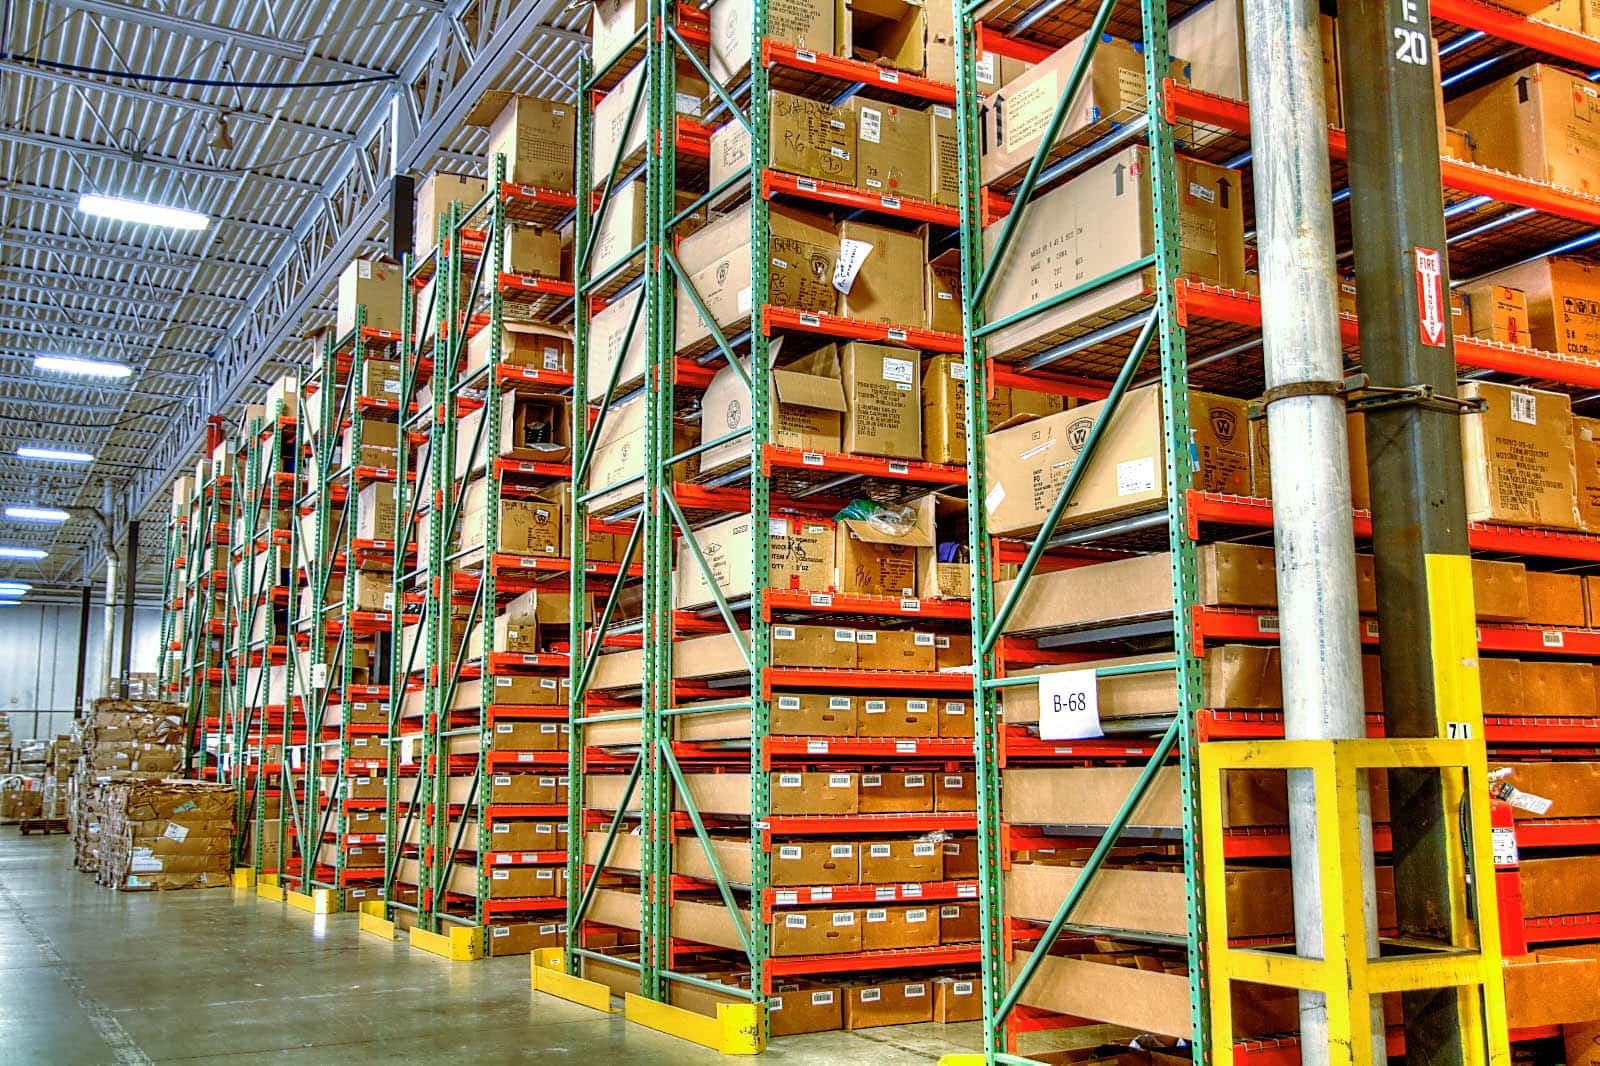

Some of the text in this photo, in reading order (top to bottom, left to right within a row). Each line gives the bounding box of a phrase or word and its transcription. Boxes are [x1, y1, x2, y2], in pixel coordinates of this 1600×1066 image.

[1393, 27, 1428, 66] 20
[1419, 257, 1437, 272] FIRE
[1053, 692, 1086, 712] B-68
[1449, 723, 1467, 739] 71
